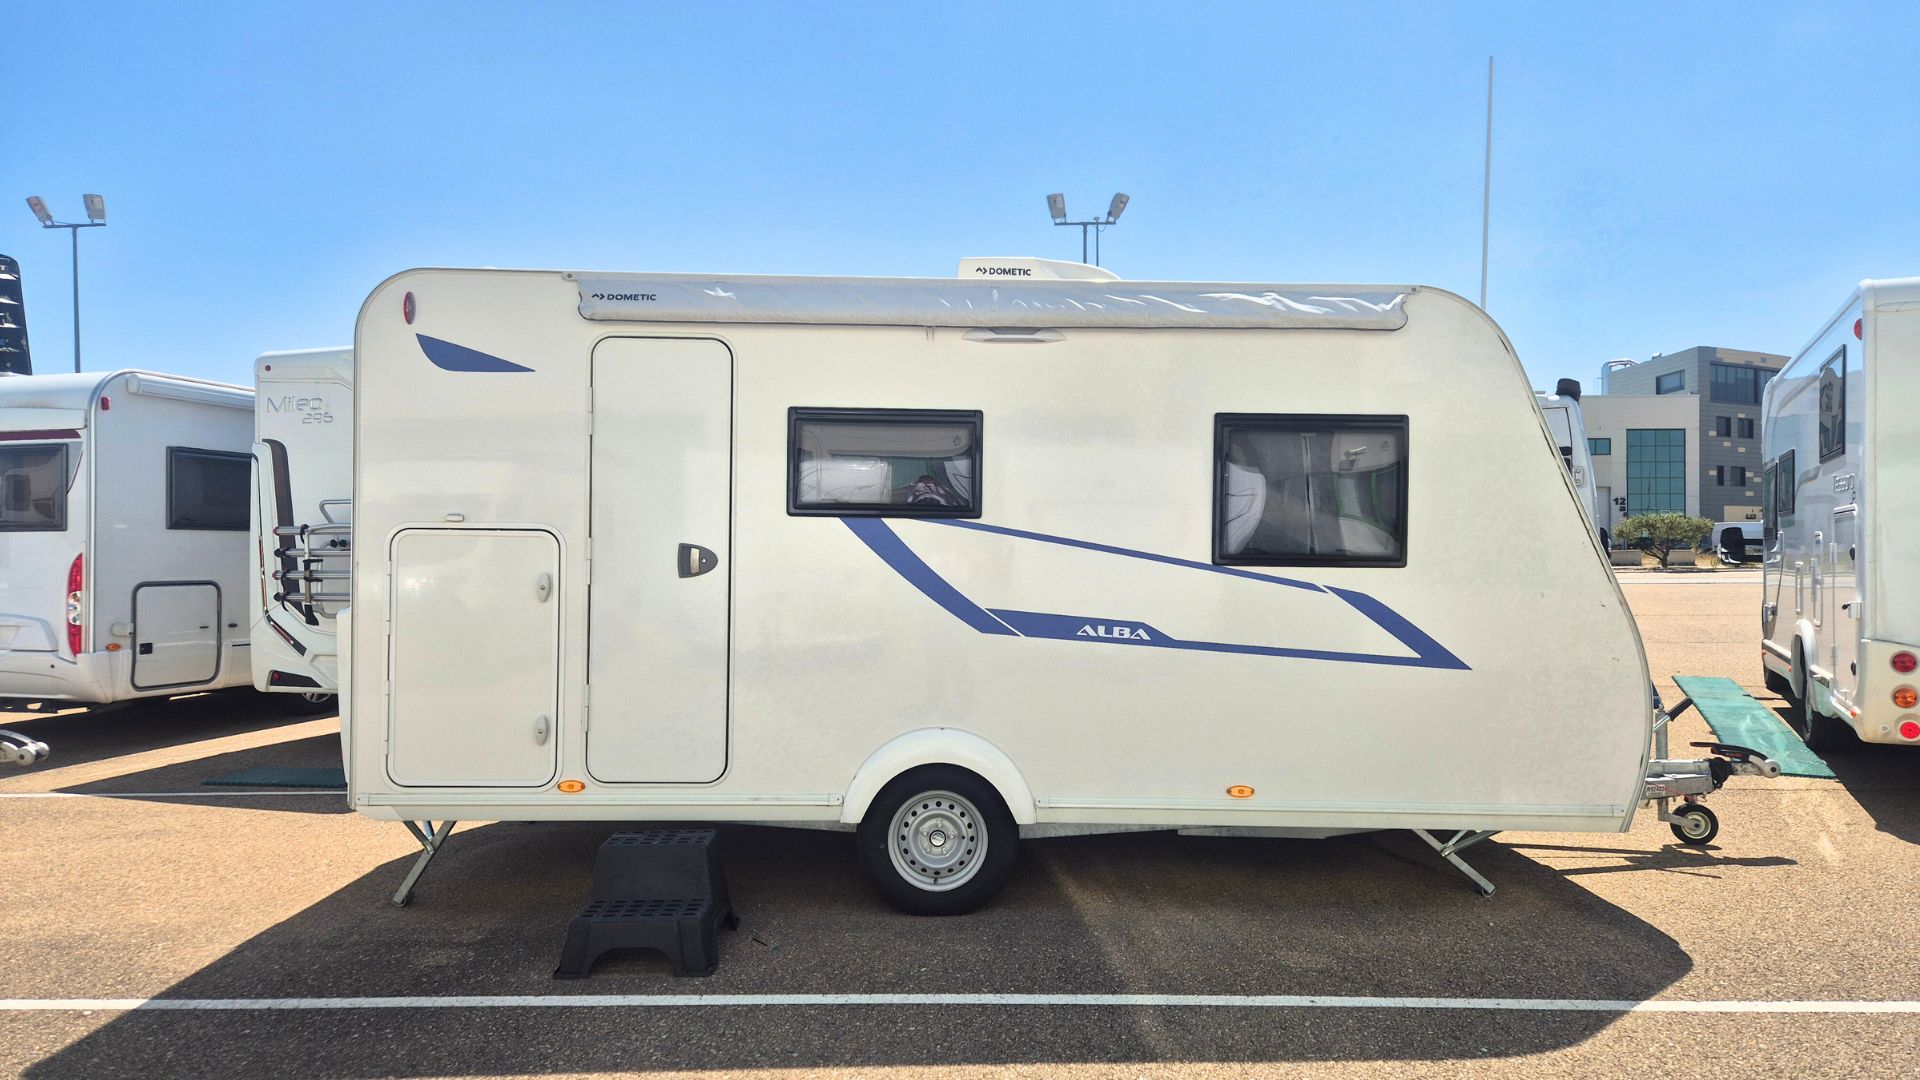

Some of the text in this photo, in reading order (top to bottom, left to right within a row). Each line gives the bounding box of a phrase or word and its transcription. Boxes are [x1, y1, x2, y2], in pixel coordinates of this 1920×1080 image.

[989, 267, 1031, 276] DOMETIC
[607, 293, 657, 301] DOMETIC
[266, 395, 323, 413] Mileo
[302, 412, 334, 424] 296
[1613, 497, 1626, 505] 12
[1076, 624, 1151, 640] ALBA
